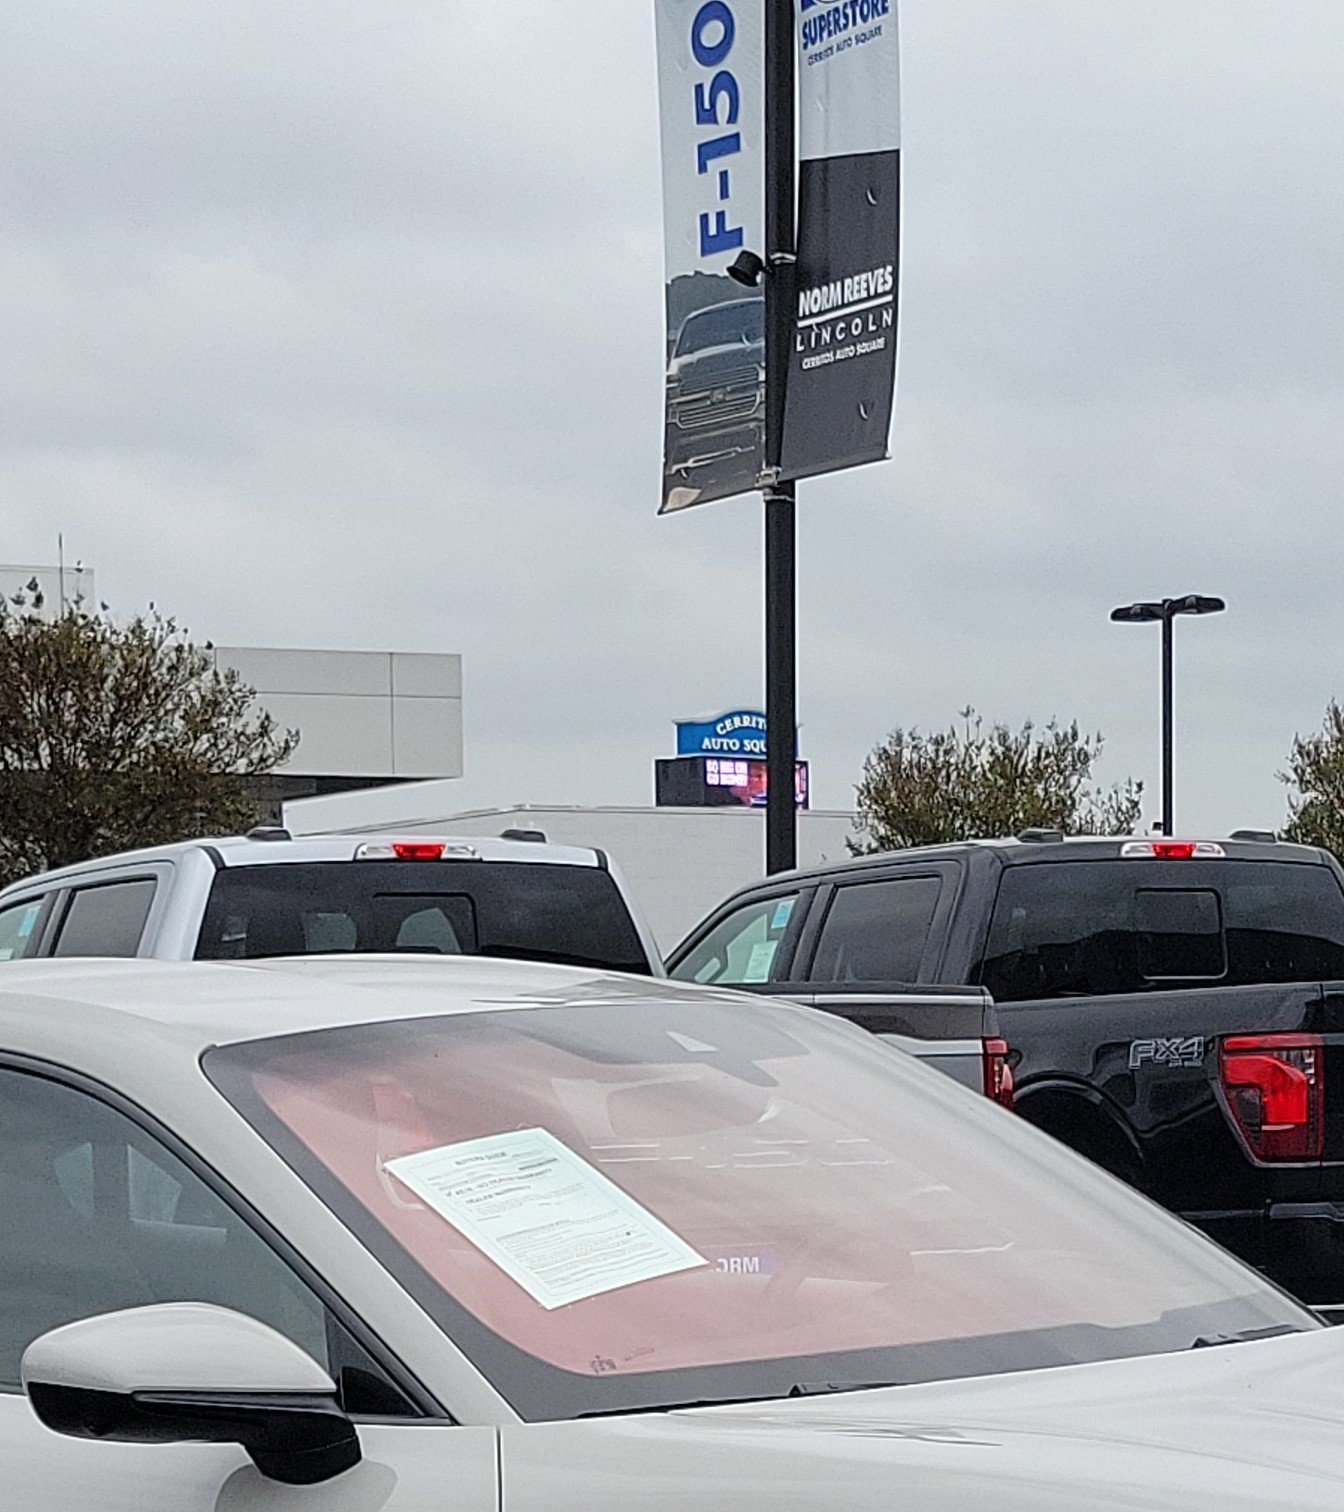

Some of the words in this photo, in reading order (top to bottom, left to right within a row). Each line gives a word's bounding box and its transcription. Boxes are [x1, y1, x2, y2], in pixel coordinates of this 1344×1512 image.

[801, 0, 889, 50] SUPERSTORE
[691, 0, 743, 257] F-150
[798, 281, 843, 318] NORM
[843, 264, 894, 305] REEVES
[796, 307, 893, 353] LINCOLN
[702, 737, 740, 751] AUTO
[716, 715, 767, 735] CERRIT
[1128, 1036, 1204, 1070] FX4
